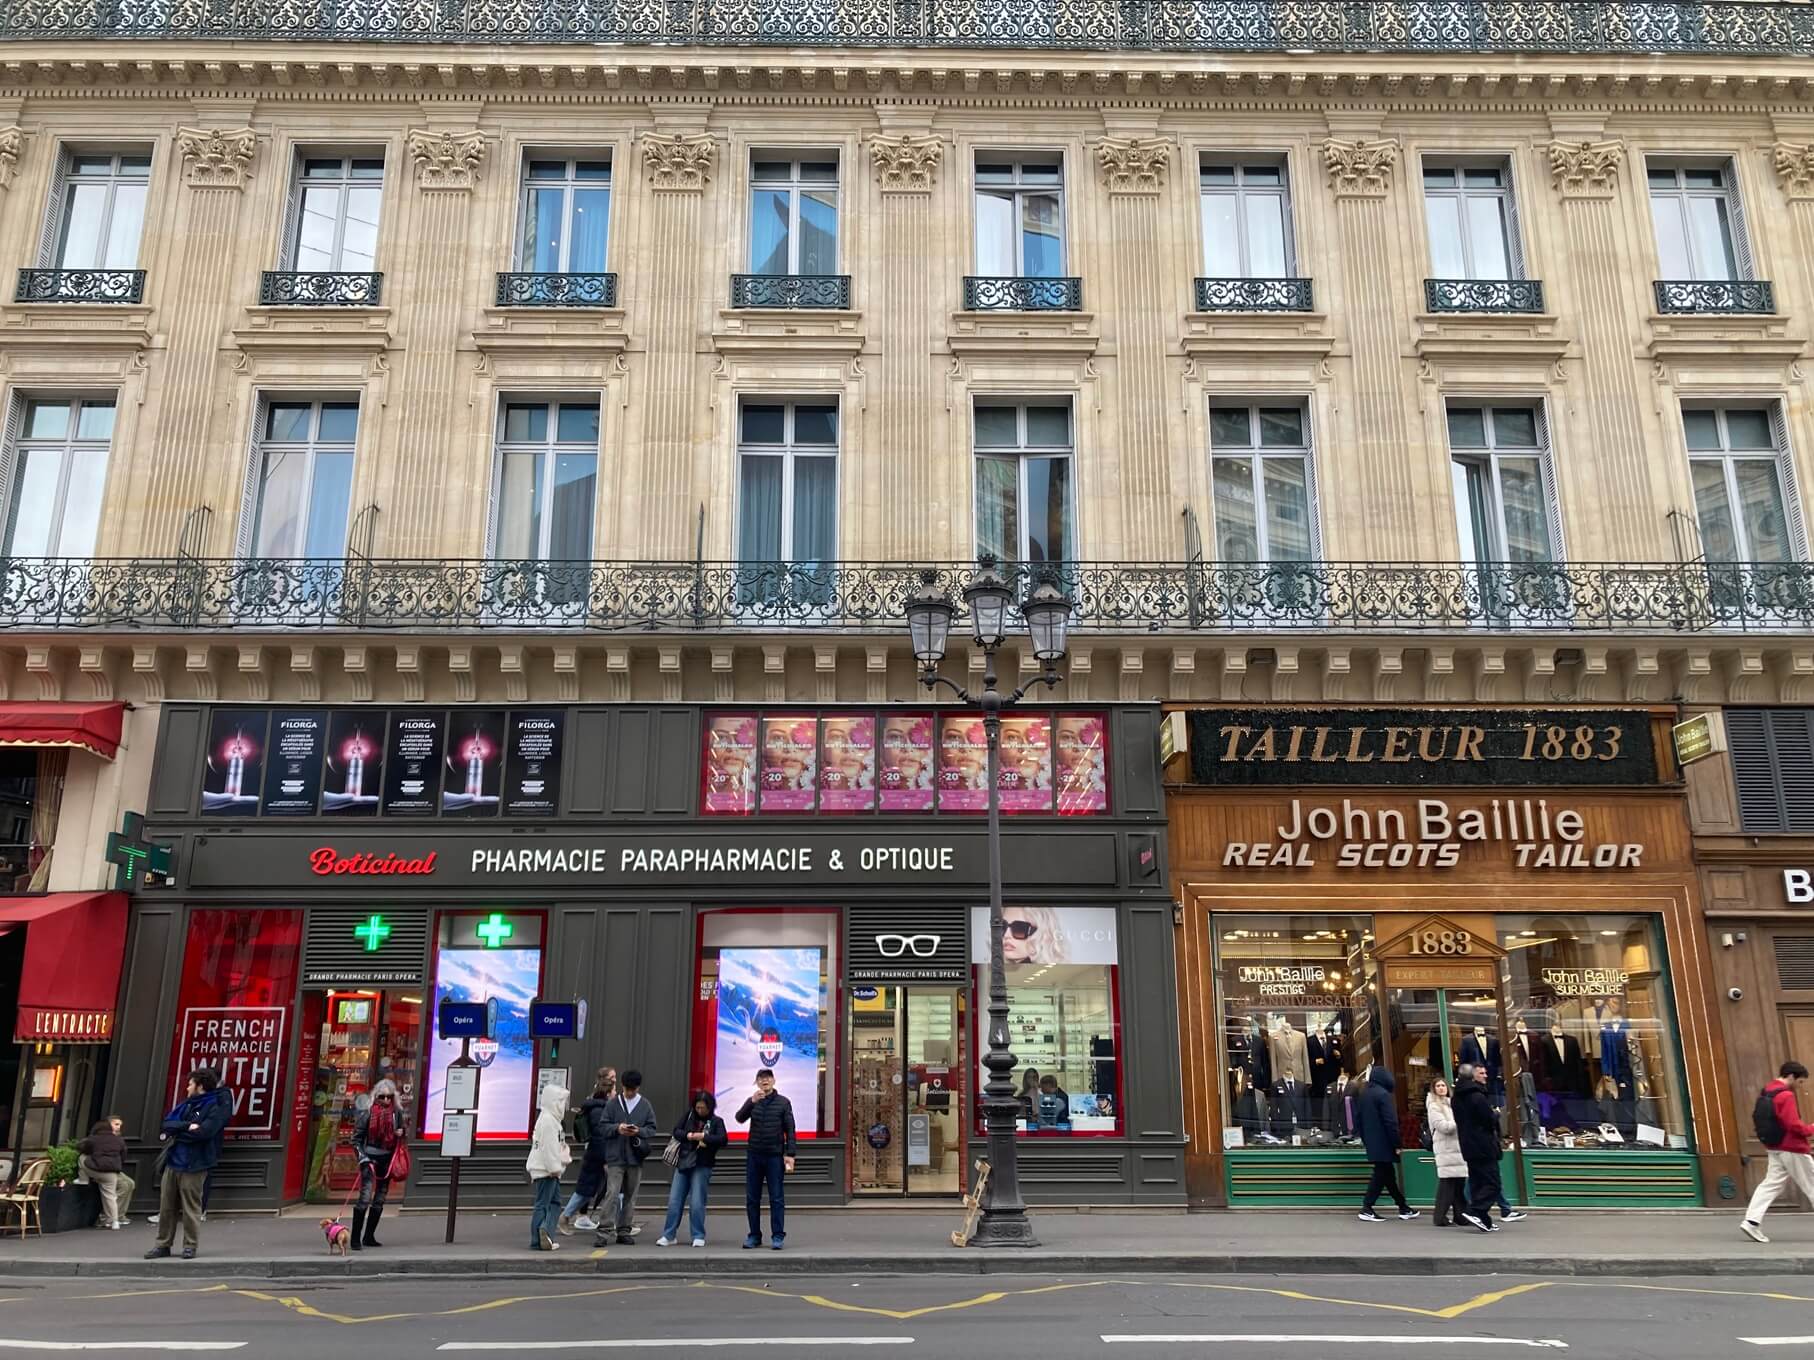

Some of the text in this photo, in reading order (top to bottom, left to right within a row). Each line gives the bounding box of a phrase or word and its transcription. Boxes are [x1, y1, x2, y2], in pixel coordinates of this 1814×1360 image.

[1219, 725, 1623, 762] TAILLEUR 1883
[1278, 799, 1584, 841] John Baillie
[310, 847, 438, 875] Boticinal
[471, 848, 954, 872] PHARMACIE PARAPHARMACIE & OPTIQUE
[1222, 843, 1643, 868] REAL SCOTS TAILOR
[1053, 929, 1112, 941] GUCCI
[1408, 931, 1472, 955] 1883
[1240, 967, 1324, 981] John Baillie
[1396, 970, 1433, 979] EXPERT
[1543, 969, 1629, 983] John Baillie
[1260, 984, 1305, 995] PRESTIGE
[1580, 985, 1623, 994] MESURE
[35, 1012, 108, 1034] L'ENTRACTE
[453, 1016, 474, 1024] Opéra
[544, 1016, 564, 1024] Opéra
[194, 1019, 275, 1038] FRENCH
[191, 1041, 272, 1053] PHARMACIE
